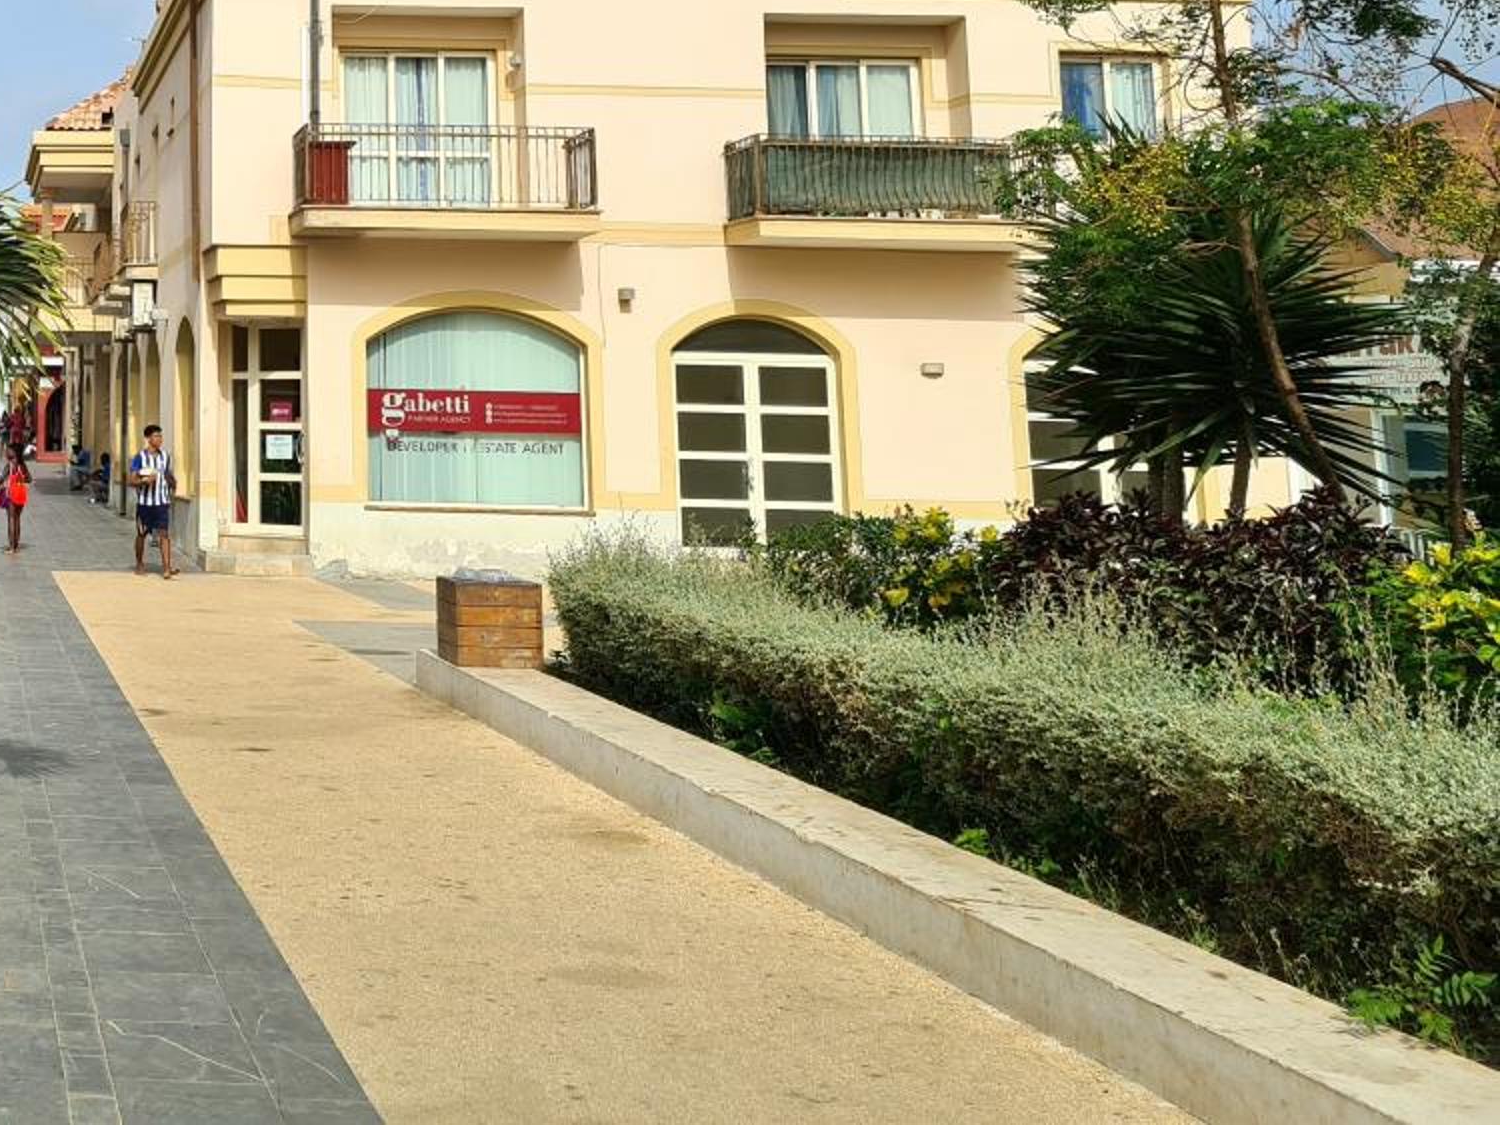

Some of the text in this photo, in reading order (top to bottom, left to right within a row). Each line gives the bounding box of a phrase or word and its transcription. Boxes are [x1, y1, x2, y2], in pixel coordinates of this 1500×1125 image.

[381, 392, 470, 427] gabetti
[387, 440, 459, 452] DEVELOPER
[521, 442, 564, 455] AGENT
